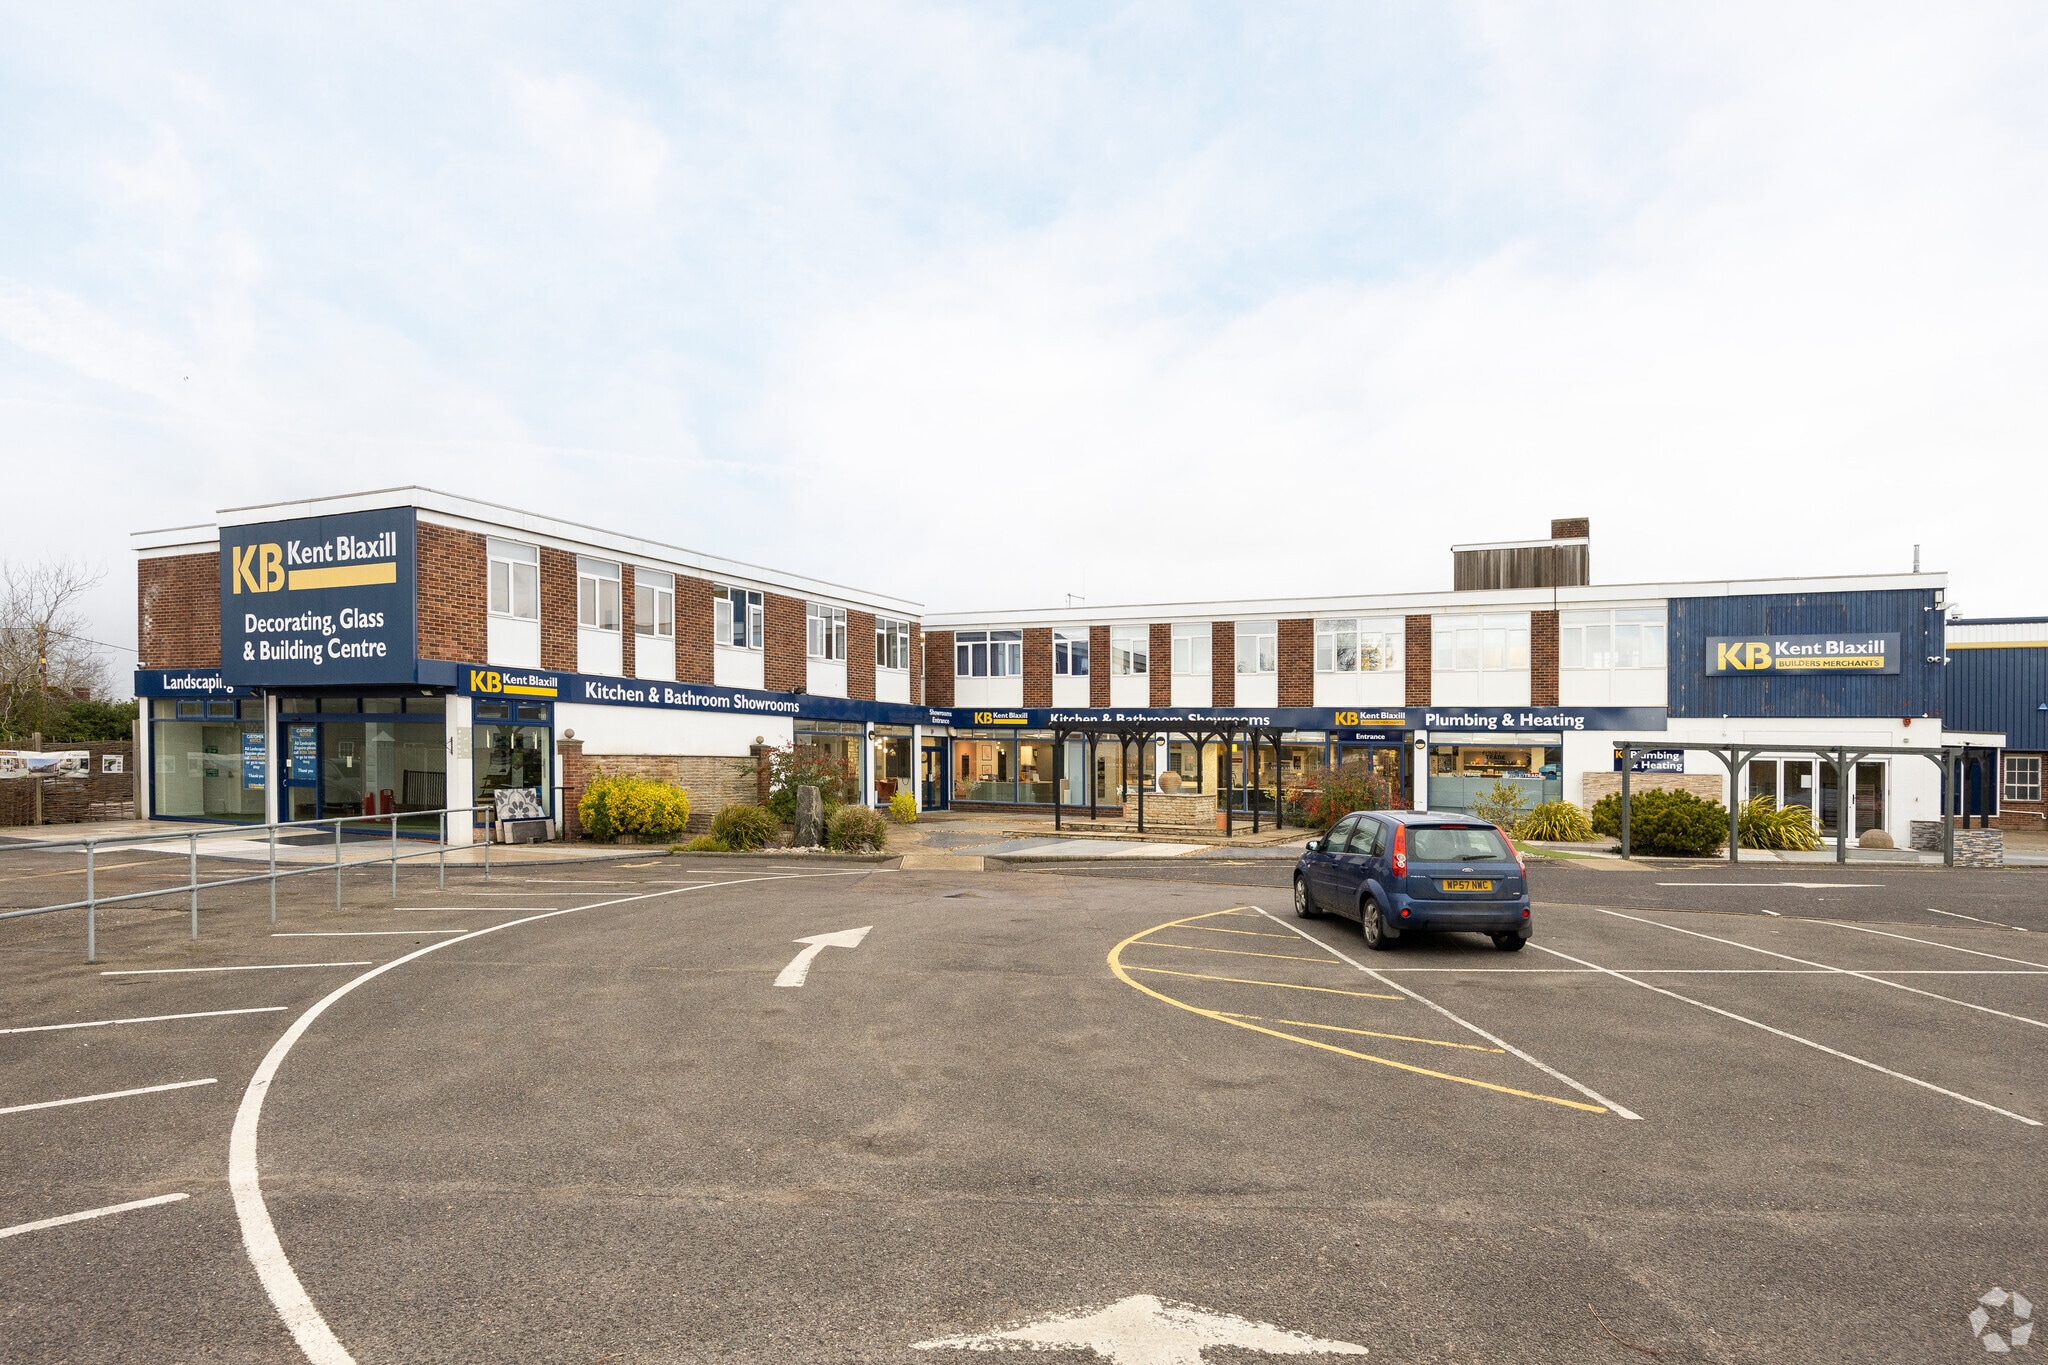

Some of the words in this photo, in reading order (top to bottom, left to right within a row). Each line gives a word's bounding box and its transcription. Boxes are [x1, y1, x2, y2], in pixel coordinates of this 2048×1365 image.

[287, 540, 333, 565] Kent
[336, 531, 397, 561] Blaxill
[232, 542, 286, 594] KB
[244, 610, 337, 636] Decorating,
[339, 607, 385, 630] Glass
[242, 640, 255, 661] &
[259, 639, 324, 666] Building
[327, 637, 387, 659] Centre
[1775, 641, 1822, 656] Kent
[1825, 640, 1885, 655] Blaxill
[1717, 642, 1772, 671] KB
[1778, 660, 1821, 668] BUILDERS
[1822, 659, 1880, 667] MERCHANTS
[470, 669, 502, 693] KB
[502, 673, 528, 686] Kent
[528, 675, 558, 688] Blaxill
[585, 681, 644, 702] Kitchen
[648, 686, 660, 703] &
[664, 687, 730, 708] Bathroom
[733, 694, 800, 713] Showrooms
[929, 709, 952, 717] Showrooms
[932, 716, 950, 724] Entrance
[974, 712, 993, 725] KB
[1335, 711, 1359, 726] KB
[1360, 711, 1380, 719] Kent
[1380, 711, 1406, 719] Blaxill
[1425, 713, 1497, 729] Plumbing
[1501, 713, 1515, 727] &
[1519, 713, 1585, 730] Heating
[1615, 750, 1623, 759] K
[1630, 750, 1680, 762] Pumbing
[1641, 761, 1683, 772] Heating
[1446, 880, 1470, 890] WP57
[1471, 880, 1489, 890] NWC
